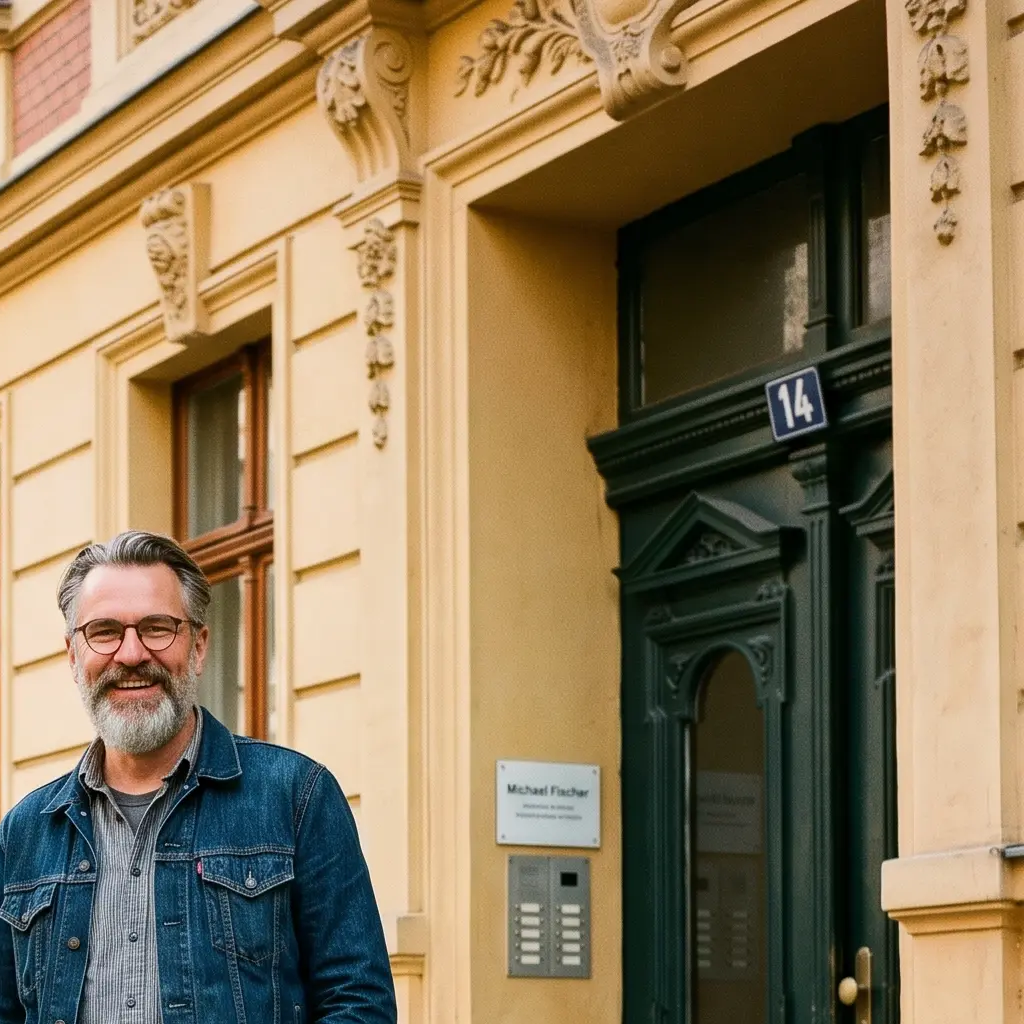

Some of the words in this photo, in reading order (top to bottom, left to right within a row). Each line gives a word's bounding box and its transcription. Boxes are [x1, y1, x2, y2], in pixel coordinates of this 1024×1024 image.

[778, 377, 814, 429] 14
[507, 784, 548, 796] Michael
[550, 786, 589, 798] Fischer
